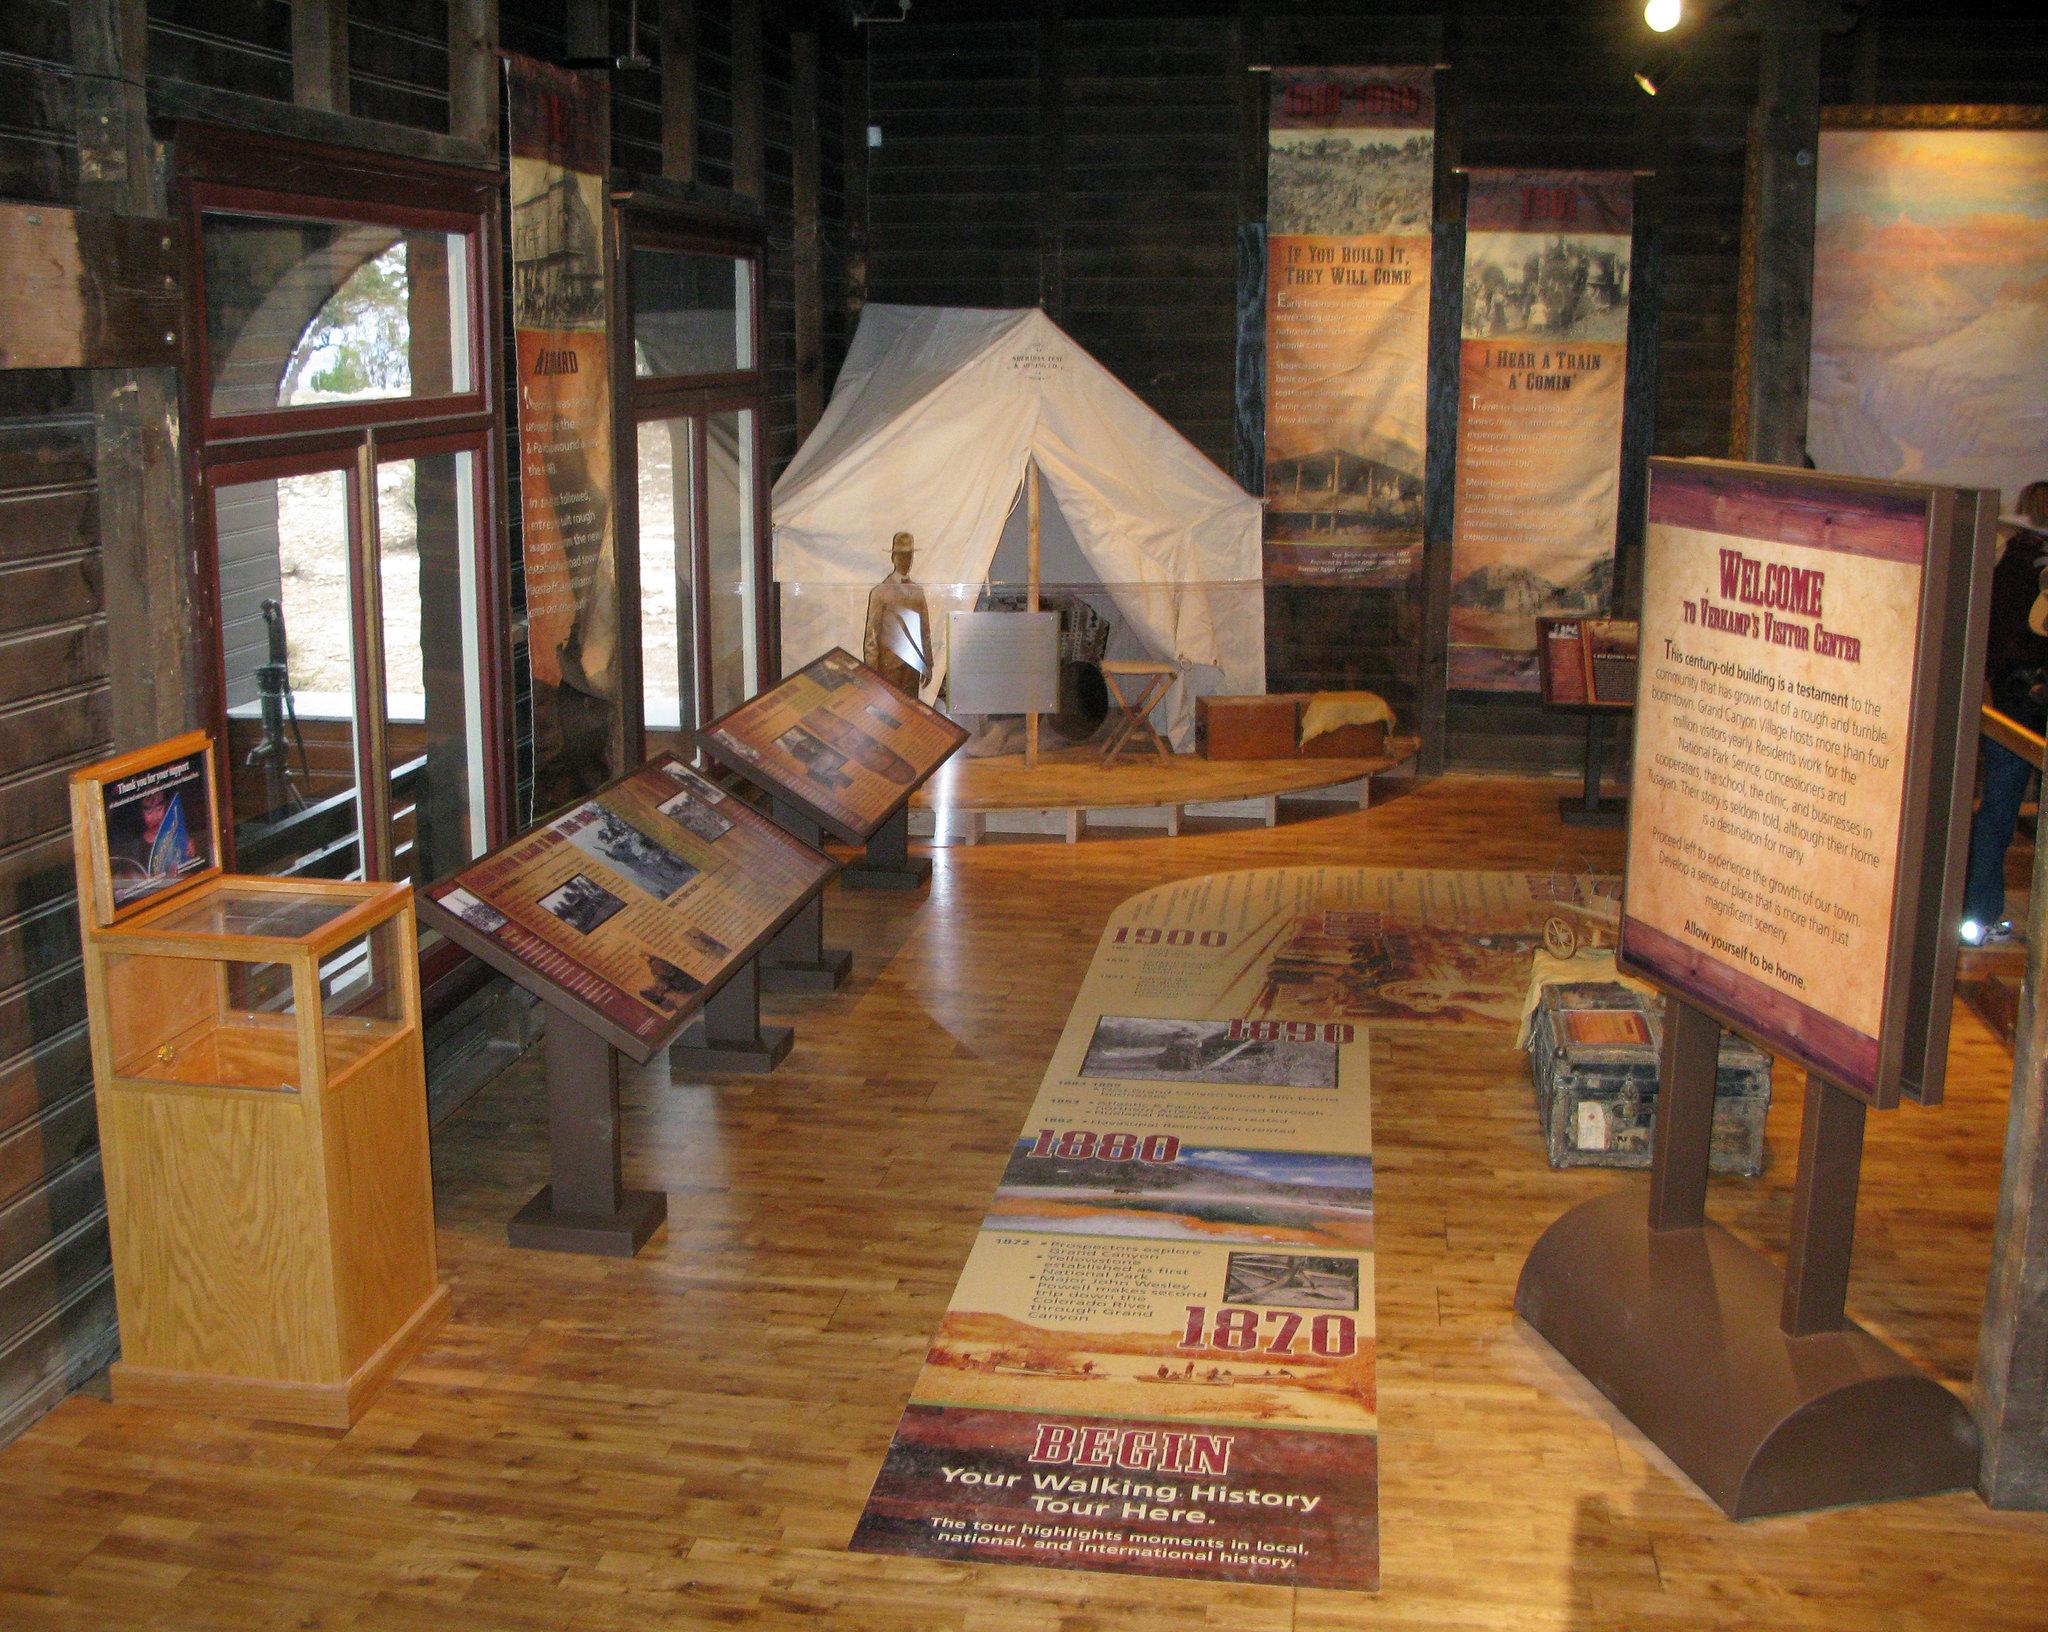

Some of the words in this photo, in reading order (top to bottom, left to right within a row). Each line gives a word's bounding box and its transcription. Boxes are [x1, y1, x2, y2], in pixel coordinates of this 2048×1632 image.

[1309, 245, 1334, 263] YOU
[1342, 247, 1384, 264] BUILD
[1286, 266, 1323, 285] THEY
[1331, 267, 1367, 285] WILL
[1374, 267, 1412, 285] COME
[1497, 351, 1535, 369] HEAR
[1556, 352, 1600, 370] TRAIN
[1719, 548, 1824, 616] WELCOME
[1683, 600, 1695, 622] TO
[1700, 599, 1759, 639] VERKAMP'S
[1764, 612, 1808, 650] VISITOR
[1814, 623, 1860, 664] CENTER
[1664, 639, 1682, 663] This
[1685, 655, 1734, 676] century-old
[1737, 664, 1774, 691] building
[1778, 674, 1784, 690] is
[1788, 682, 1793, 693] a
[1797, 682, 1848, 708] testament
[1852, 697, 1861, 711] to
[1865, 699, 1880, 717] the
[1656, 668, 1698, 693] community
[1700, 680, 1716, 695] that
[1719, 682, 1732, 699] has
[1734, 690, 1760, 705] grown
[1764, 699, 1778, 712] out
[1781, 701, 1790, 715] of
[1793, 707, 1798, 718] a
[1800, 710, 1828, 729] rough
[1831, 718, 1849, 733] and
[1852, 721, 1887, 744] tumble
[1673, 715, 1698, 733] million
[1700, 725, 1726, 743] visitors
[1728, 736, 1752, 752] yearly.
[1756, 739, 1796, 765] Residents
[1799, 756, 1821, 771] work
[1825, 760, 1838, 778] for
[1841, 766, 1856, 785] the
[1698, 700, 1723, 719] Grand
[1725, 707, 1756, 730] Canyon
[1760, 718, 1787, 741] Village
[1790, 726, 1813, 746] hosts
[1816, 738, 1840, 754] more
[1843, 742, 1864, 763] than
[1868, 749, 1888, 769] four
[1678, 737, 1710, 758] National
[1713, 748, 1729, 764] Park
[1732, 755, 1761, 779] Service,
[1765, 768, 1824, 799] concessioners
[1827, 791, 1846, 805] and
[1648, 769, 1678, 791] Tusayan.
[1681, 781, 1699, 798] Their
[1701, 791, 1720, 810] story
[1722, 800, 1728, 810] is
[1730, 801, 1759, 821] seldom
[1763, 812, 1780, 833] told,
[1784, 821, 1824, 848] although
[1827, 837, 1848, 855] their
[1851, 842, 1880, 868] home
[1704, 769, 1717, 782] the
[1720, 775, 1746, 796] school,
[1749, 784, 1763, 801] the
[1766, 791, 1788, 812] clinic,
[1792, 802, 1809, 817] and
[1812, 808, 1861, 836] businesses
[1862, 826, 1872, 839] in
[1702, 814, 1709, 825] is
[1710, 818, 1715, 828] a
[1717, 817, 1761, 844] destination
[1764, 834, 1776, 852] for
[1779, 843, 1804, 865] many.
[1652, 826, 1682, 850] Proceed
[1683, 840, 1696, 856] left
[1698, 849, 1706, 860] to
[1708, 853, 1750, 880] experience
[1753, 869, 1767, 886] the
[1769, 878, 1800, 900] growth
[1803, 891, 1813, 904] of
[1815, 897, 1831, 914] our
[1834, 903, 1861, 927] town.
[1659, 851, 1689, 875] Develop
[1691, 868, 1696, 878] a
[1698, 870, 1719, 888] sense
[1721, 879, 1730, 892] of
[1732, 881, 1752, 903] place
[1755, 893, 1772, 910] that
[1775, 903, 1780, 915] is
[1783, 908, 1806, 927] more
[1809, 918, 1829, 936] than
[1830, 927, 1848, 947] just
[1112, 927, 1228, 948] 1900
[1705, 895, 1752, 925] magnificent
[1754, 918, 1787, 945] scenery.
[1684, 919, 1709, 943] Allow
[1711, 935, 1748, 961] yourself
[1750, 951, 1759, 967] to
[1762, 955, 1773, 974] be
[1775, 962, 1805, 990] home.
[1224, 1018, 1354, 1045] 1890
[1027, 1128, 1180, 1164] 1880
[1045, 1263, 1131, 1271] established
[1048, 1256, 1141, 1264] Yellowstone
[1050, 1248, 1096, 1256] Grand
[1038, 1282, 1090, 1291] Powell
[1151, 1290, 1206, 1298] second
[1043, 1269, 1108, 1277] National
[1136, 1282, 1189, 1290] Wesley
[1031, 1304, 1096, 1314] through
[1103, 1309, 1152, 1317] Grand
[1033, 1297, 1106, 1306] Colorado
[1069, 1291, 1113, 1299] down
[1028, 1312, 1088, 1320] Canyon
[1178, 1305, 1358, 1358] 1870
[1028, 1423, 1235, 1475] BEGIN
[940, 1466, 1022, 1490] Your
[1032, 1472, 1177, 1502] Walking
[1191, 1484, 1320, 1510] History
[1030, 1496, 1110, 1516] Tour
[1121, 1500, 1216, 1525] Here.
[930, 1517, 969, 1531] The
[973, 1520, 1016, 1534] tour
[1020, 1524, 1122, 1545] highlights
[1128, 1531, 1225, 1550] moments
[1230, 1539, 1250, 1551] in
[1256, 1541, 1309, 1556] local,
[936, 1530, 1027, 1549] national,
[1033, 1538, 1072, 1551] and
[1077, 1541, 1212, 1562] international
[1219, 1551, 1296, 1570] history.
